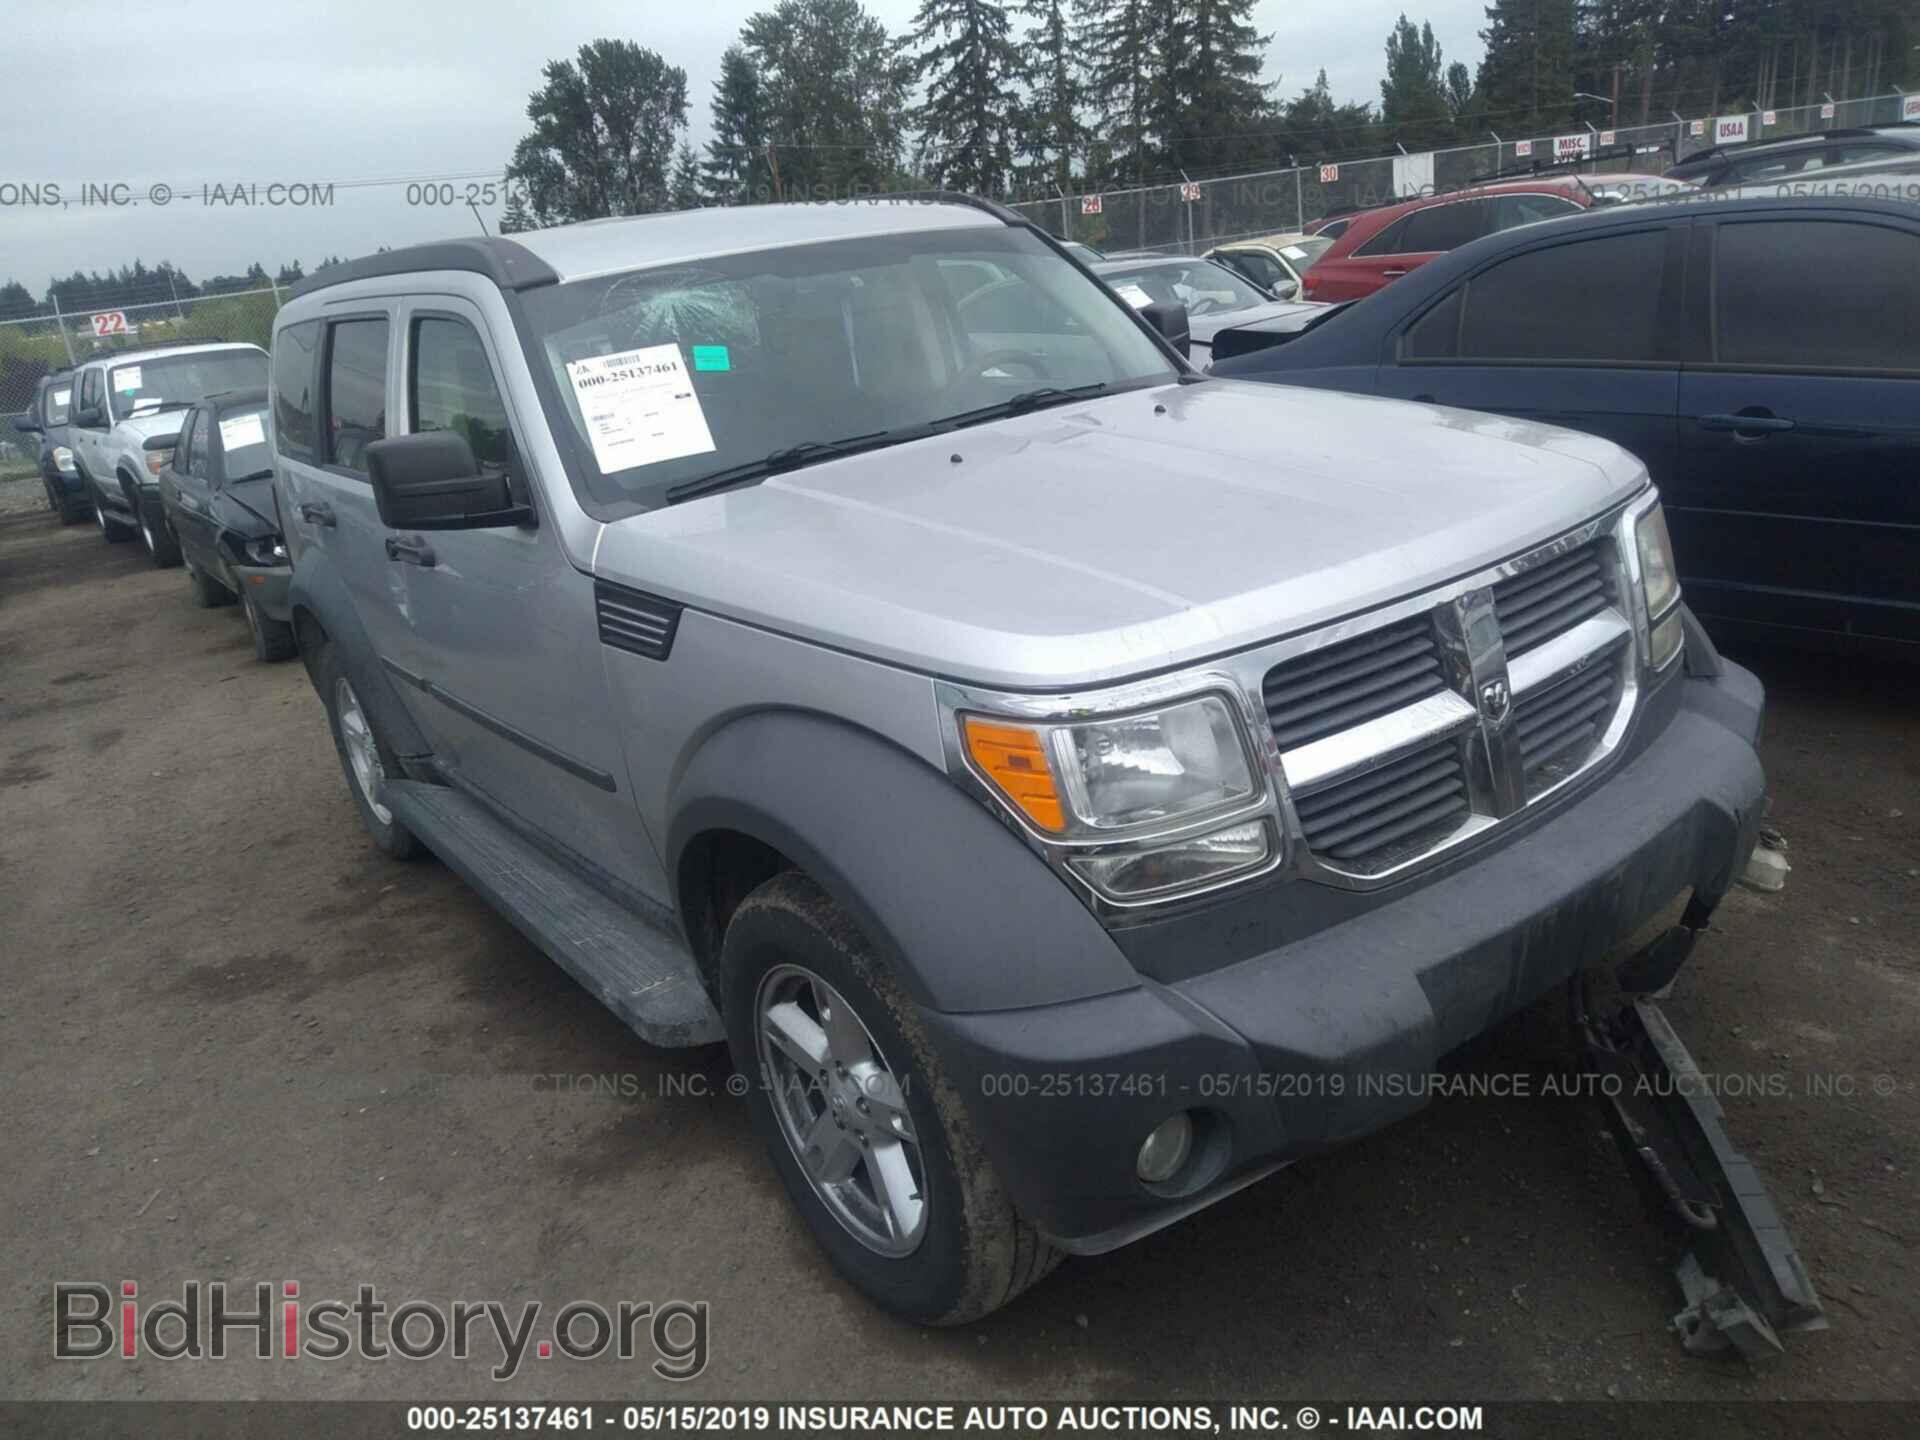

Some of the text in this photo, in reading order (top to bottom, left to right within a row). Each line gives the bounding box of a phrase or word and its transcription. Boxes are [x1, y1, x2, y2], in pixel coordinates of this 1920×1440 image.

[1719, 121, 1744, 138] USAA
[1559, 137, 1585, 149] MISC.
[1321, 166, 1337, 180] 30
[1183, 185, 1200, 198] 29
[94, 313, 126, 336] 22
[577, 361, 679, 390] 000-25137461
